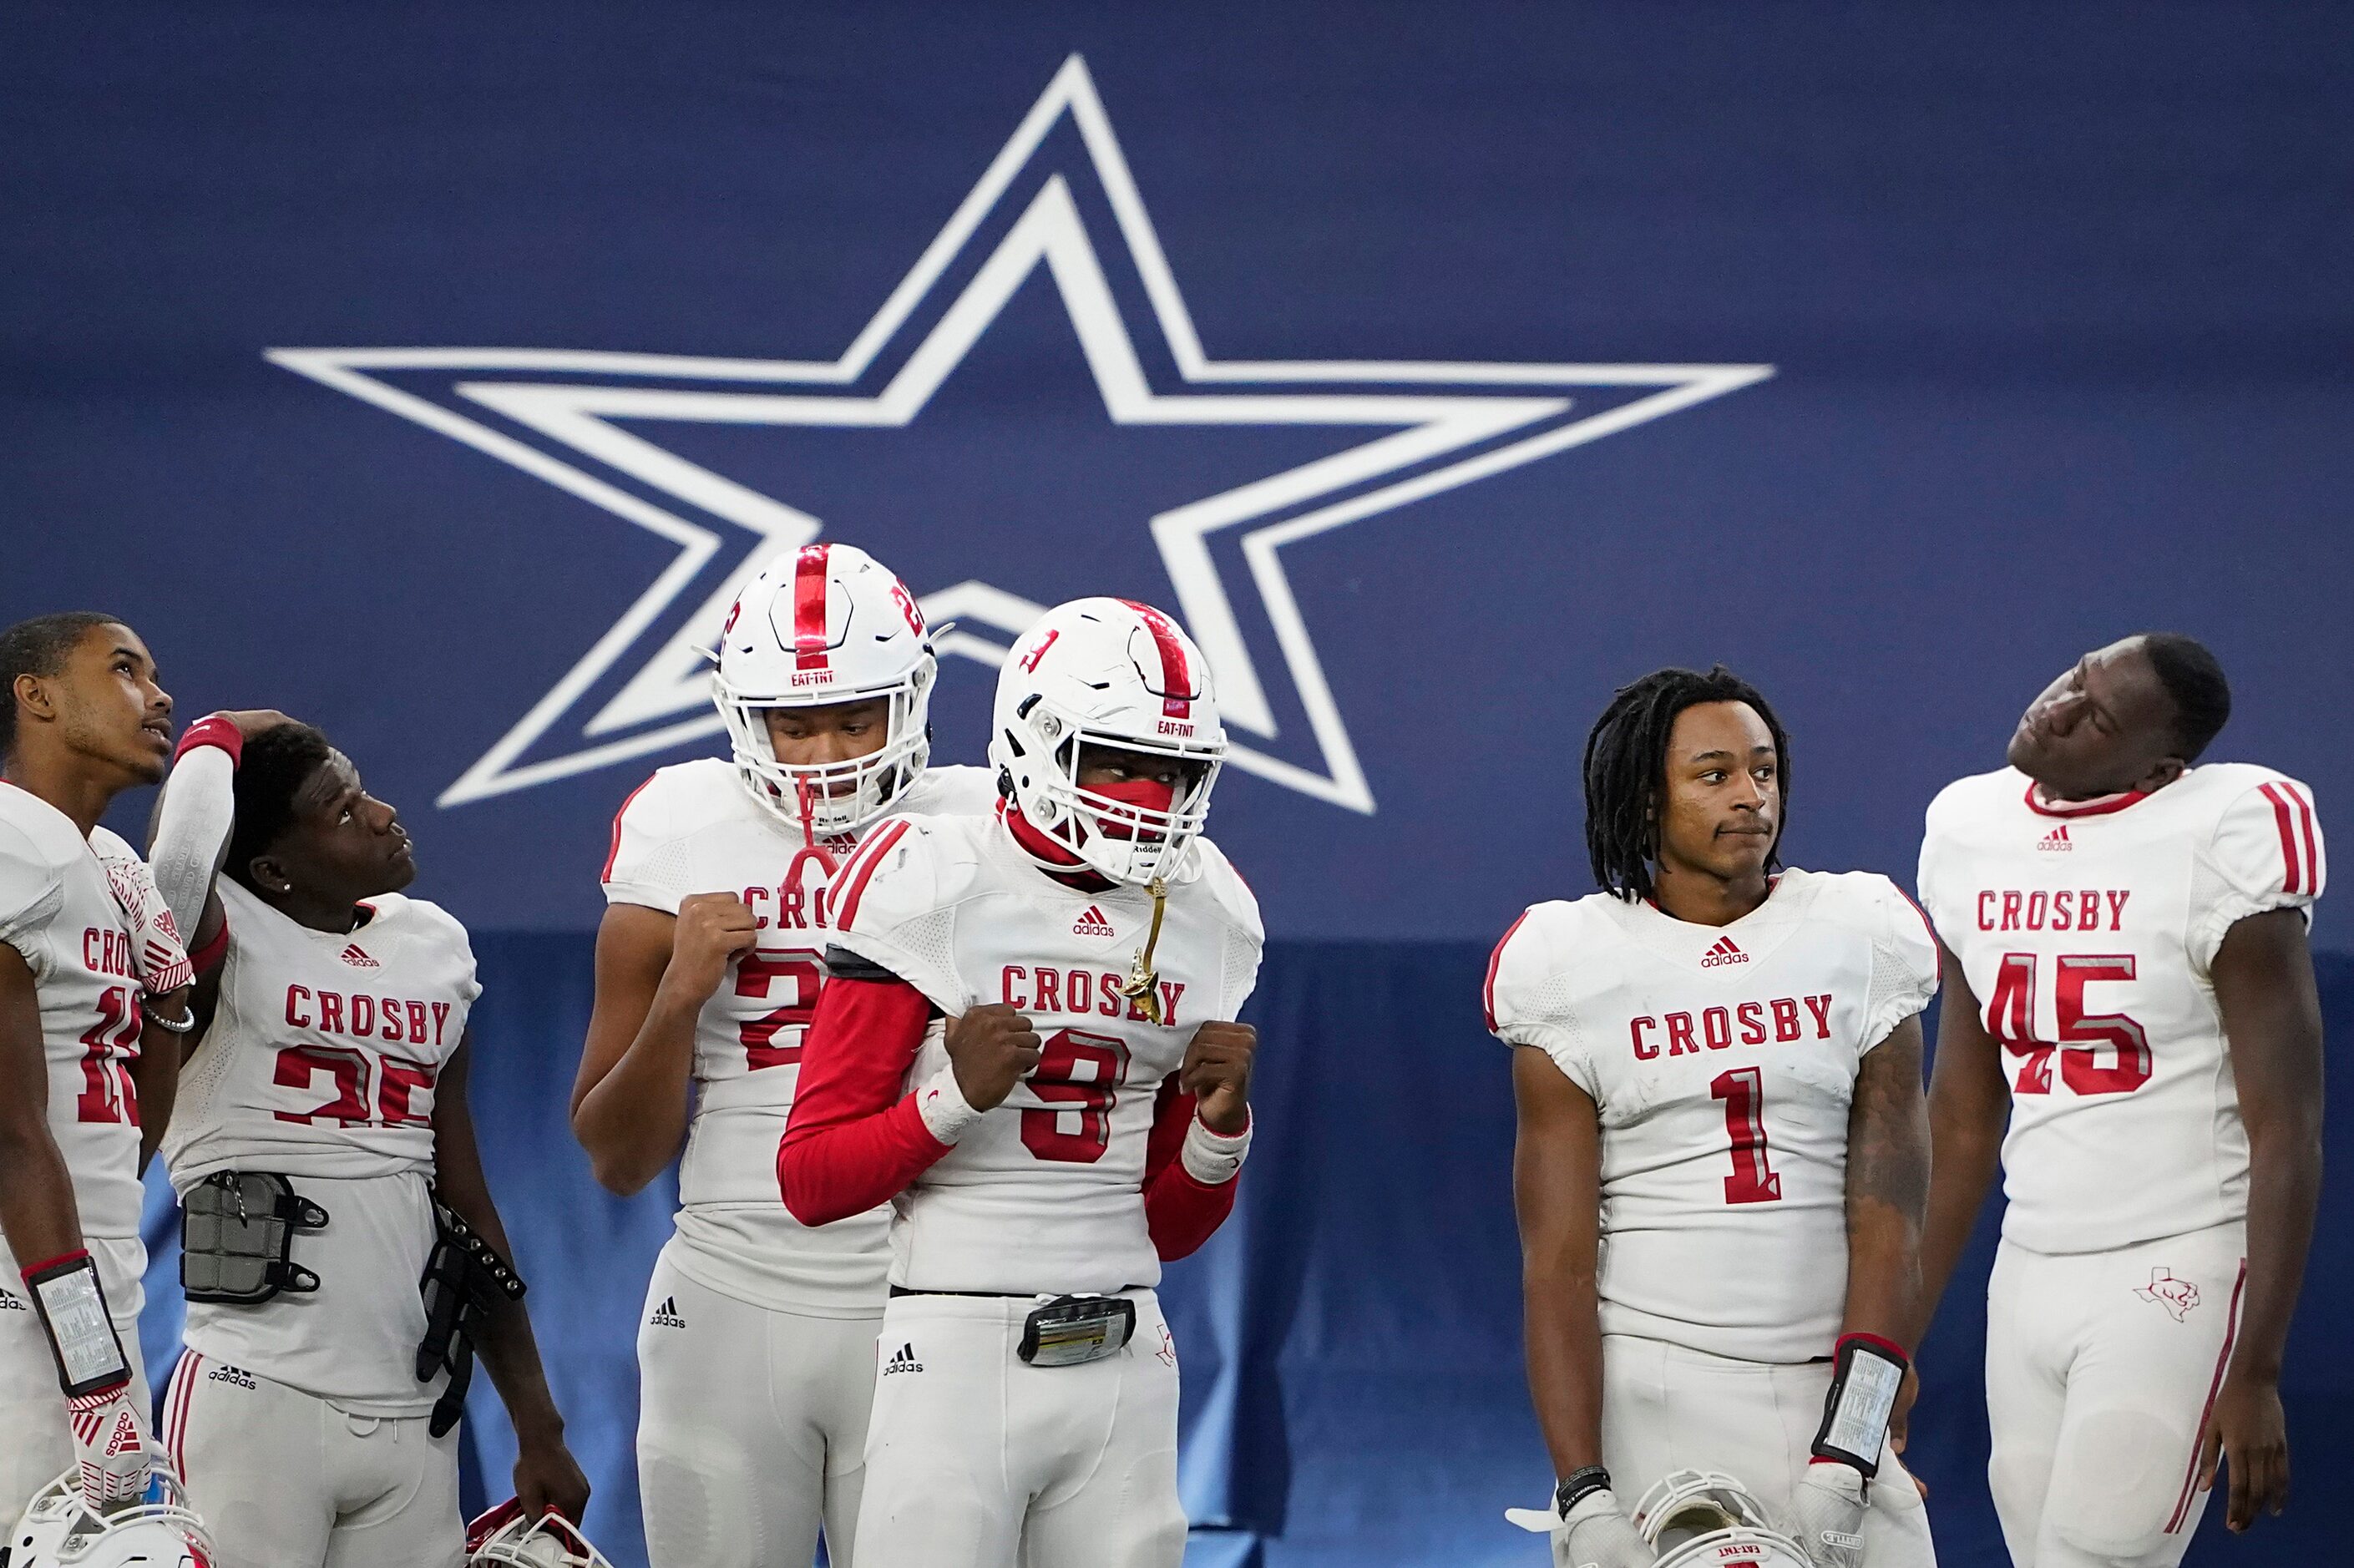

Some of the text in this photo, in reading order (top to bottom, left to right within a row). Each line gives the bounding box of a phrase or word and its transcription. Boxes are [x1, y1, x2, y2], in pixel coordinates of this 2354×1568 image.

[791, 670, 833, 686] EAT-TNT
[1157, 721, 1194, 737] EAT-TNT
[2037, 840, 2072, 852] adidas
[1073, 922, 1115, 937] adidas
[1977, 890, 2130, 931] CROSBY
[1701, 953, 1749, 968] adidas
[286, 984, 450, 1045] CROSBY
[1002, 965, 1186, 1027] CROSY
[1631, 994, 1832, 1061] CROSBY
[1987, 953, 2153, 1095] 45
[1020, 1028, 1131, 1164] 9
[1710, 1067, 1781, 1205] 1
[208, 1371, 256, 1390] adidas
[105, 1412, 129, 1456] adidas
[1718, 1545, 1761, 1557] EAT-TNT
